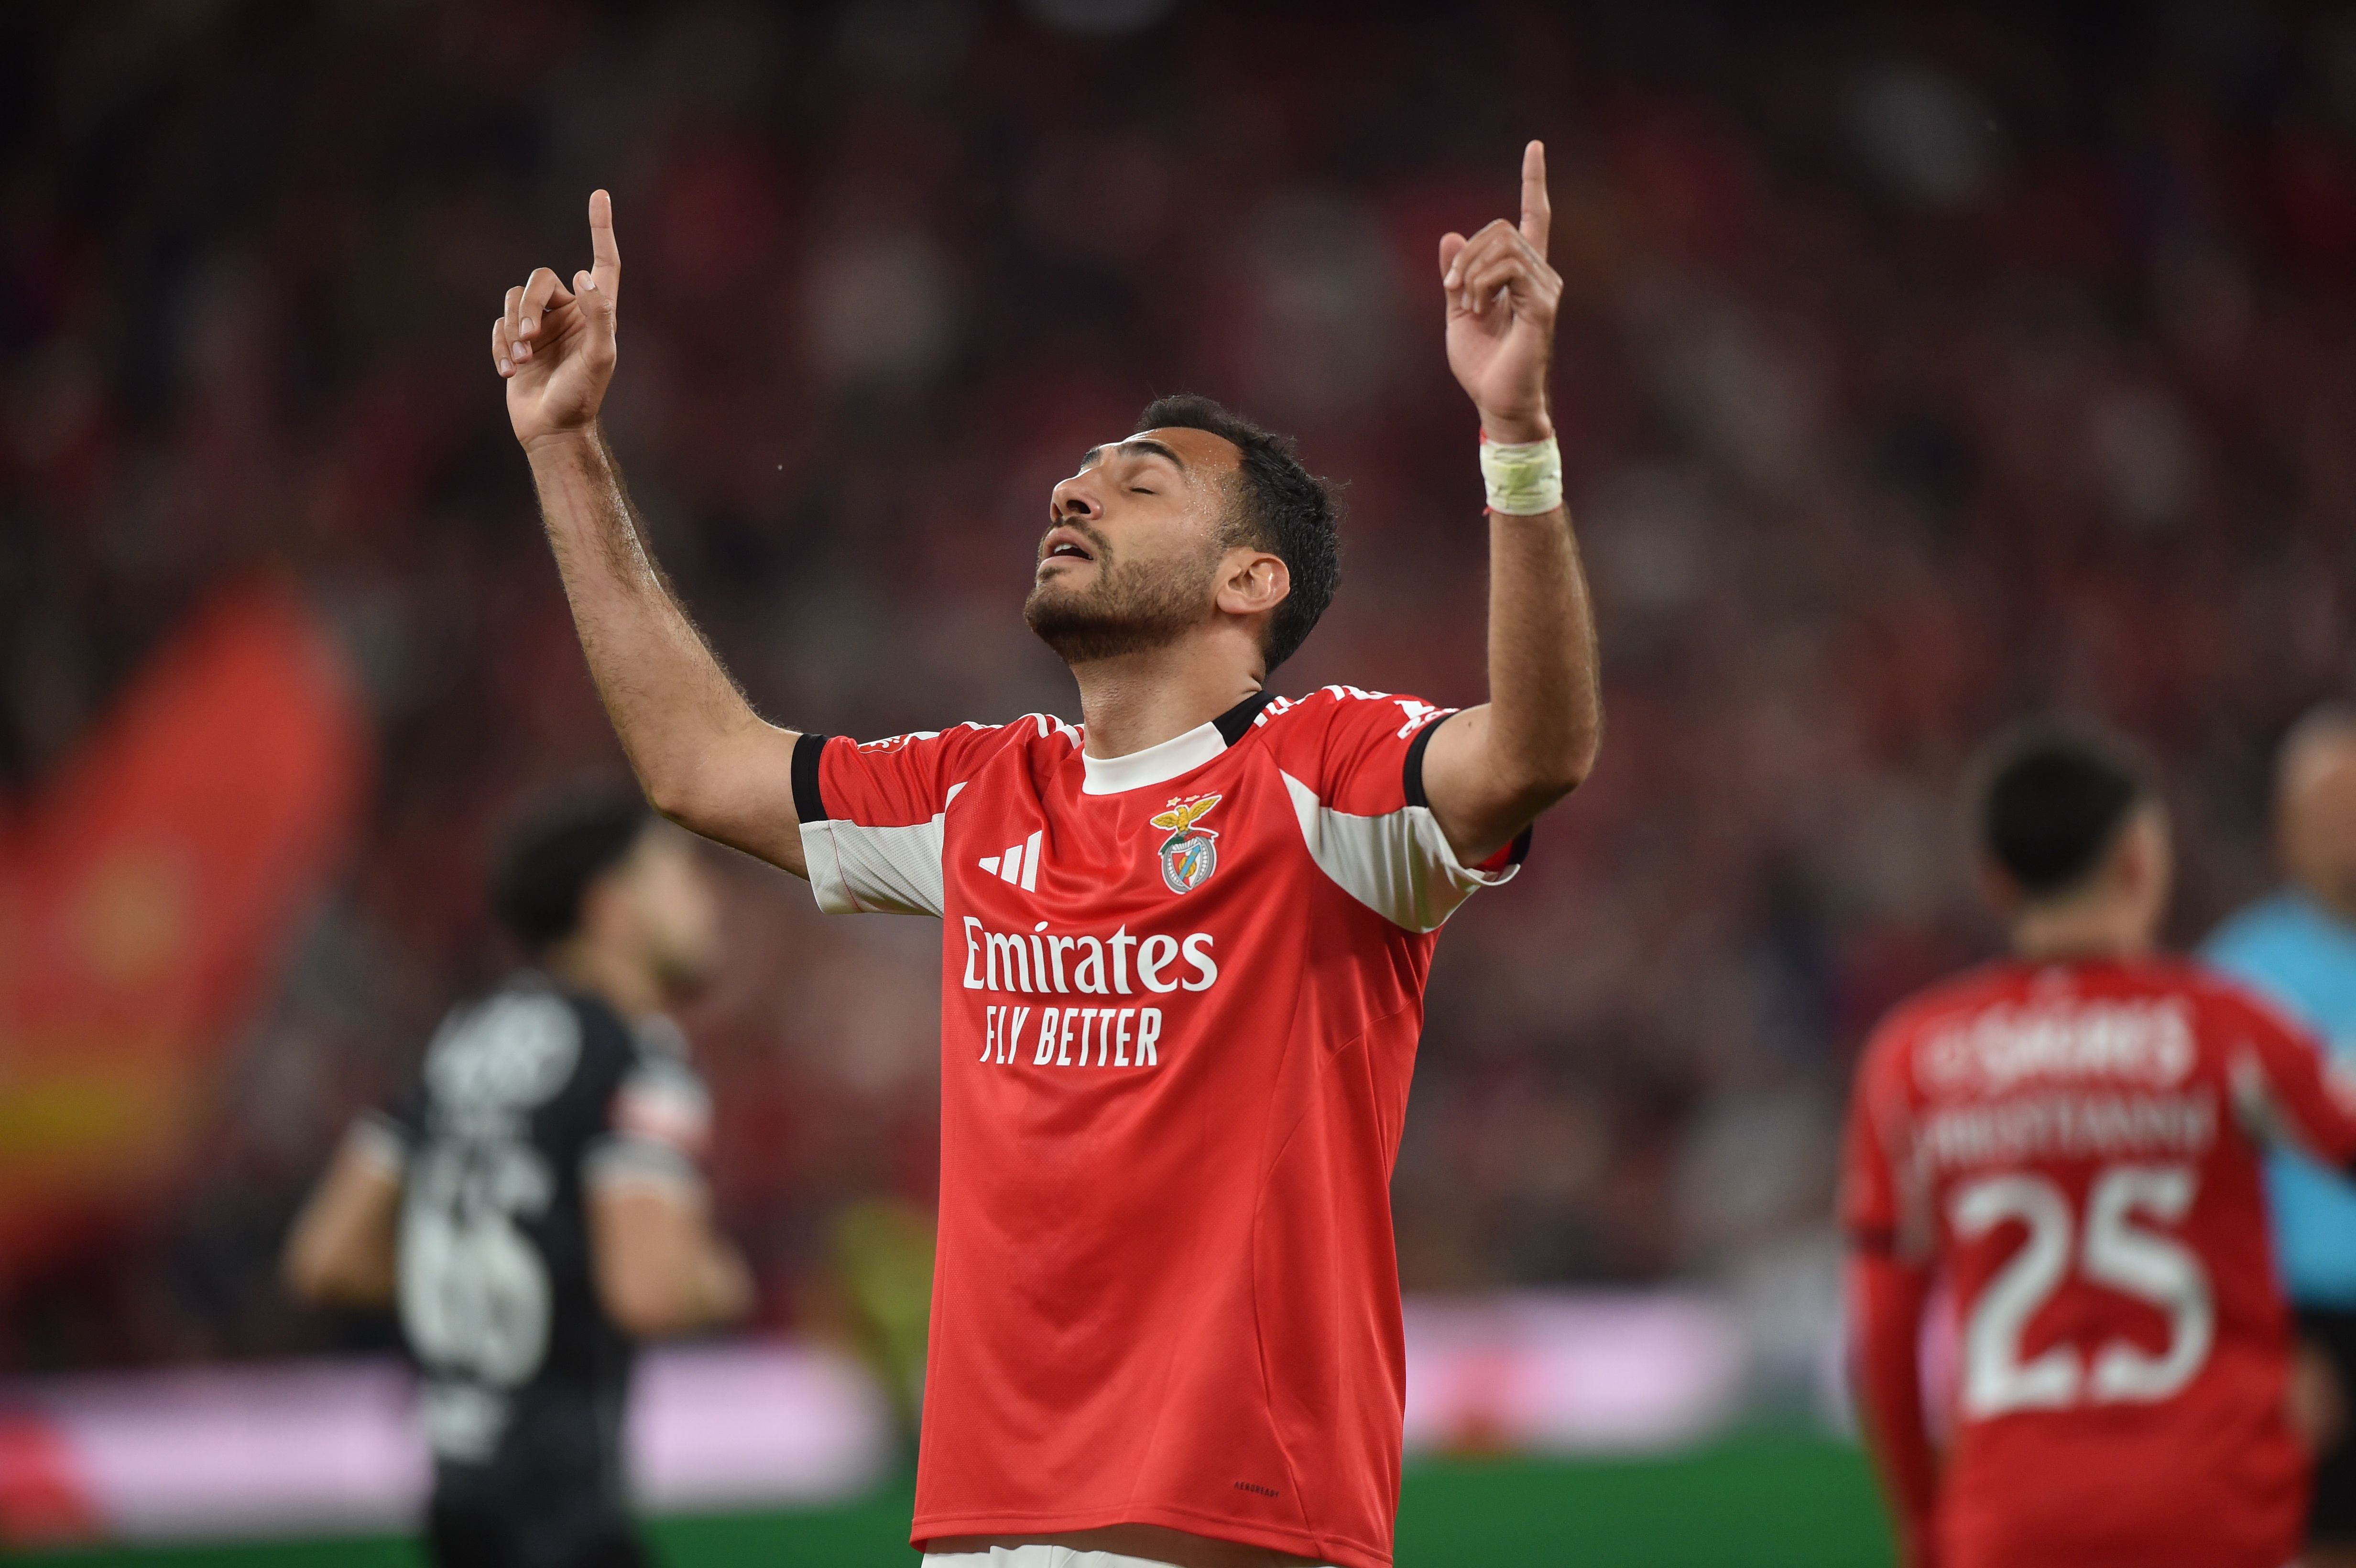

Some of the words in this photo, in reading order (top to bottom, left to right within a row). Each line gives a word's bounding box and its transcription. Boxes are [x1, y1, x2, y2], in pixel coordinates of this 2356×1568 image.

[963, 916, 1218, 994] Emirates
[979, 1005, 1030, 1064] FLY
[1033, 1007, 1162, 1067] BETTER
[1948, 1166, 2214, 1419] 25
